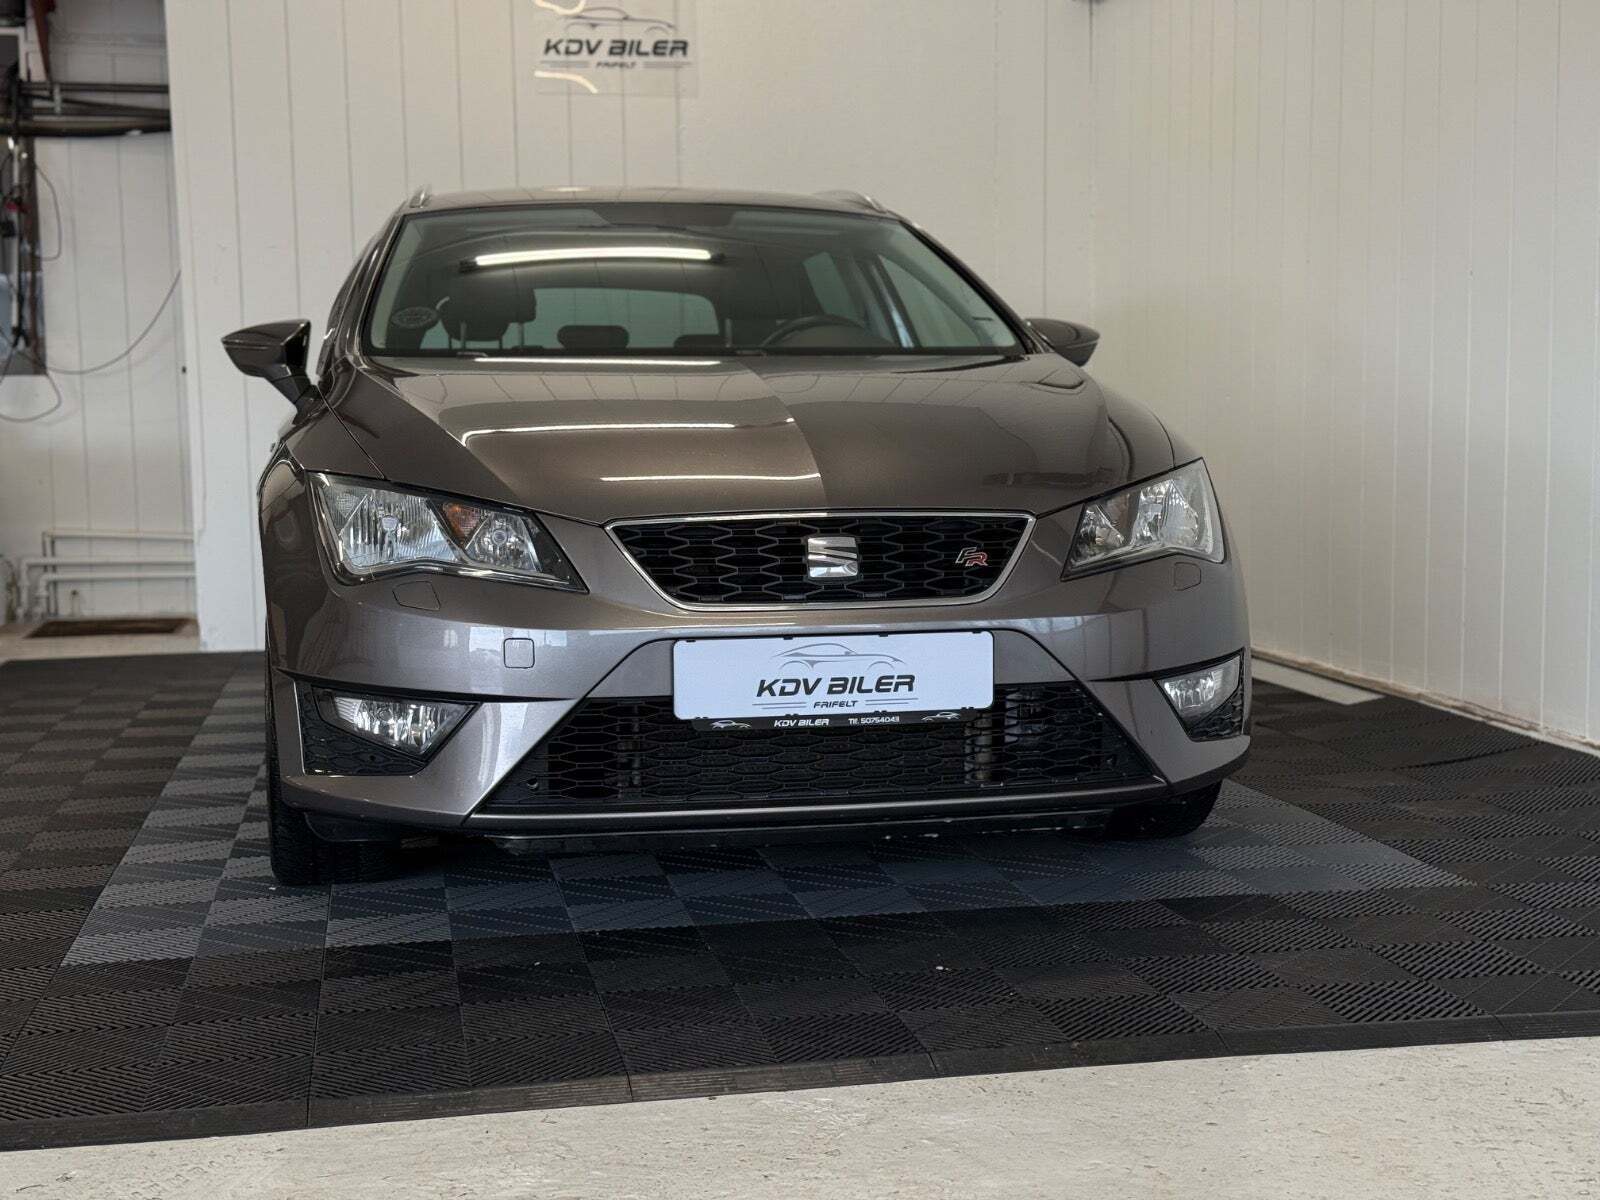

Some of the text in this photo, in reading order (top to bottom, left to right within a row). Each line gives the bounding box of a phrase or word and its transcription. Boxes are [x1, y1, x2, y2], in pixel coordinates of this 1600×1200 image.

[543, 39, 689, 57] KDV BILER
[955, 546, 988, 566] FR
[756, 674, 916, 698] KDV BILER
[813, 700, 858, 709] FRIFELT
[773, 719, 797, 728] KDV
[797, 718, 830, 727] BILER
